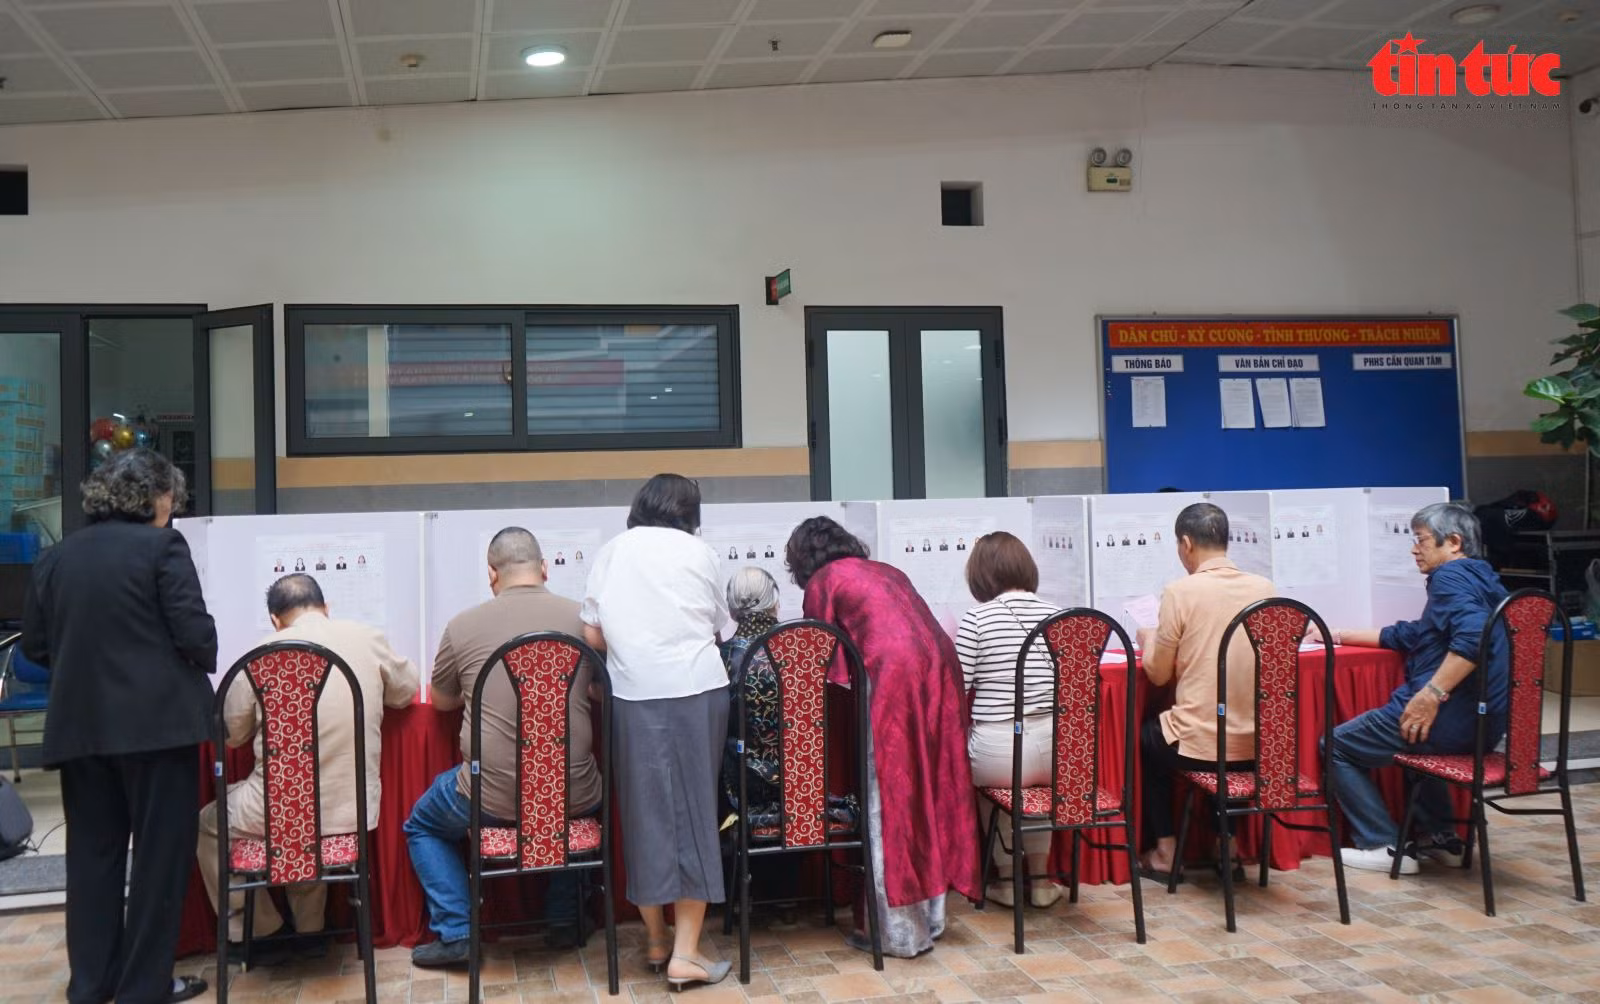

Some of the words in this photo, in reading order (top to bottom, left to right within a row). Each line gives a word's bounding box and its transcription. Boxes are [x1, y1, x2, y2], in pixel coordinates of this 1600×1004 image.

[1119, 326, 1148, 342] DÂN
[1151, 325, 1178, 342] CHỦ
[1209, 327, 1254, 342] CƯƠNG
[1262, 325, 1294, 342] TÌNH
[1296, 327, 1350, 342] THƯƠNG
[1358, 325, 1400, 341] TRÁCH
[1124, 358, 1153, 368] THÔNG
[1155, 357, 1172, 368] BÁO
[1363, 357, 1384, 368] PHHS
[1404, 356, 1425, 367] QUAN
